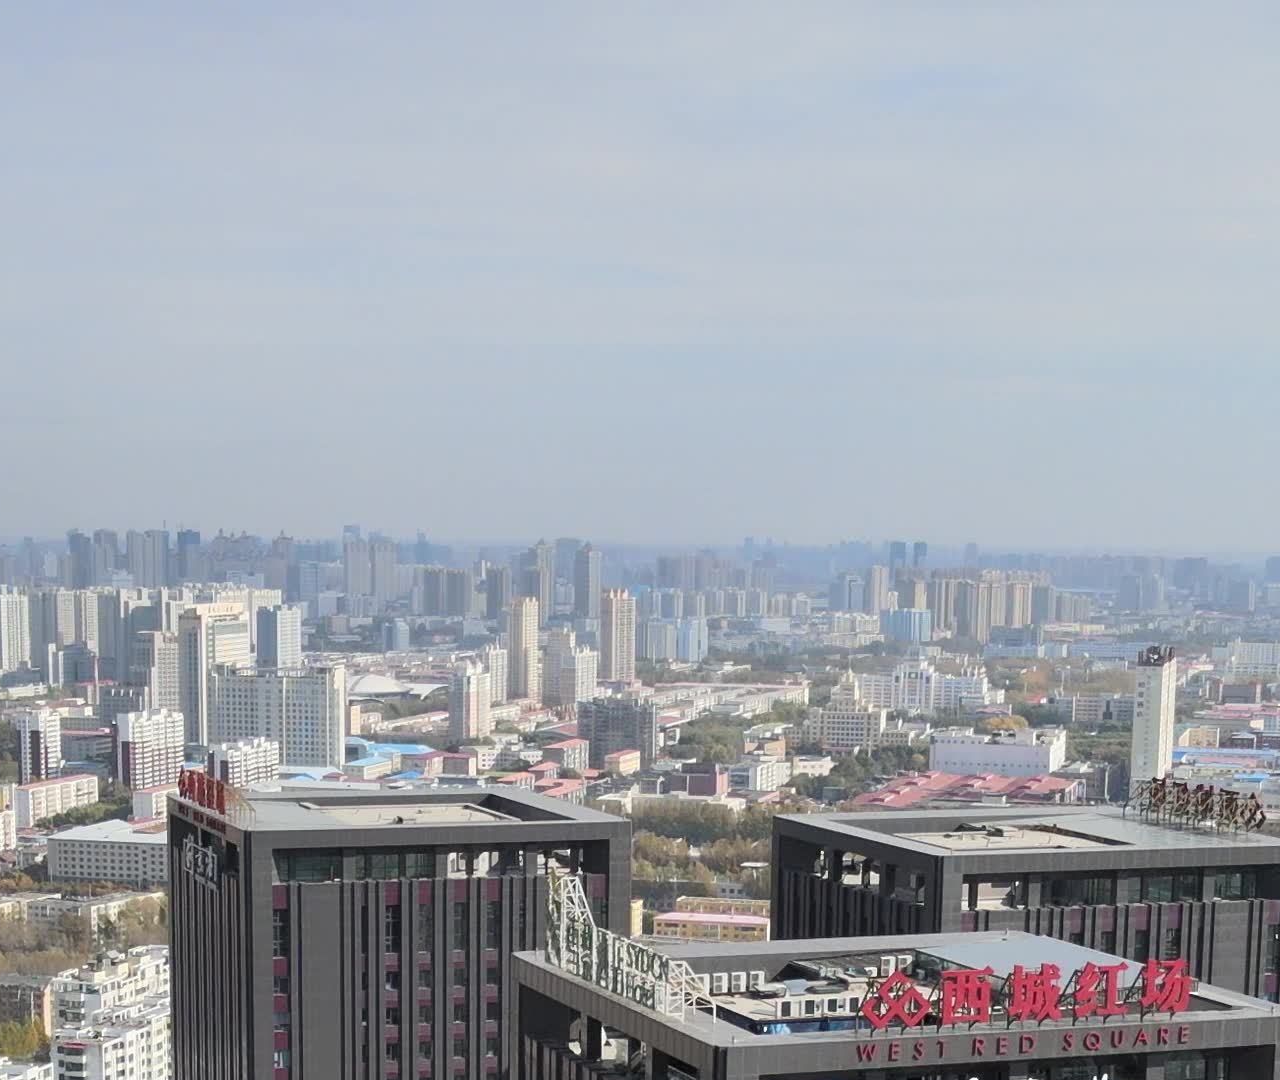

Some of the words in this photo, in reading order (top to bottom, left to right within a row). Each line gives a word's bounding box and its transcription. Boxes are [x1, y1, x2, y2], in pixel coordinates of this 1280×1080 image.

[941, 959, 1192, 1025] 西城红场
[856, 1039, 945, 1063] WEST
[971, 1033, 1038, 1056] RED
[1063, 1025, 1192, 1051] SQUARE
